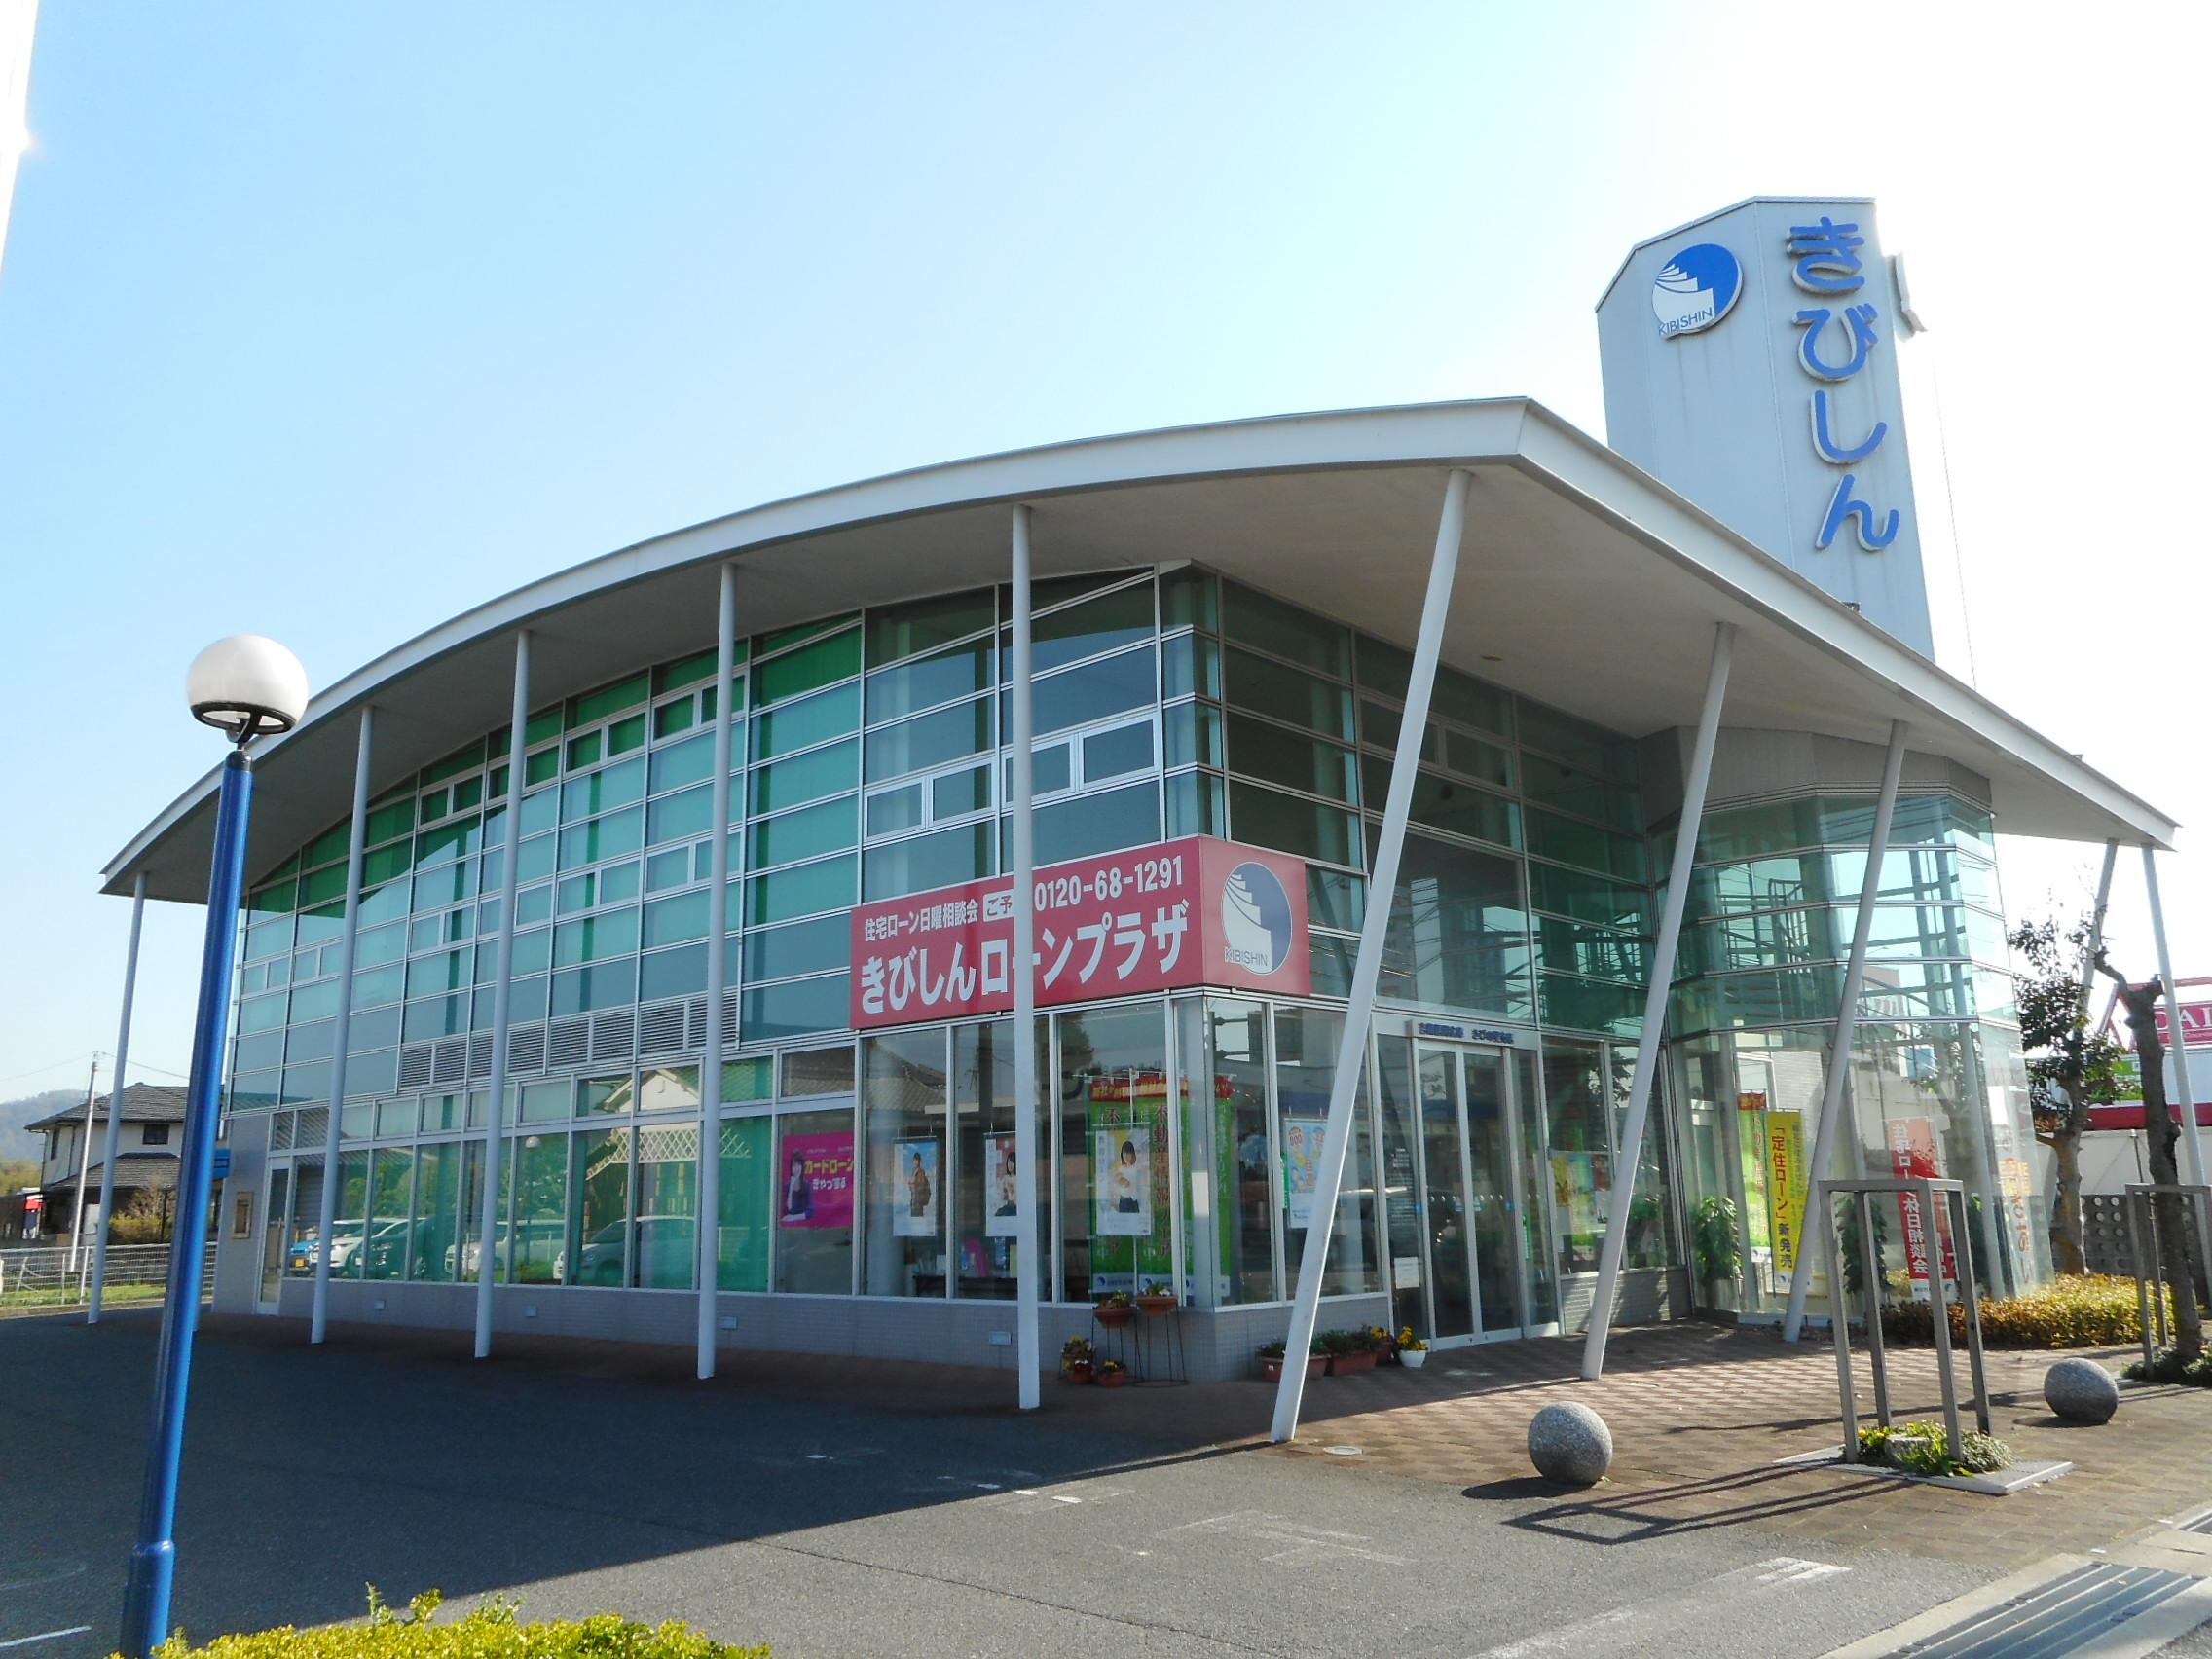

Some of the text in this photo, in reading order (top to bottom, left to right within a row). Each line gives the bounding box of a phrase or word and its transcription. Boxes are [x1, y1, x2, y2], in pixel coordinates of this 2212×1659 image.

[1658, 306, 1714, 336] KIBISHIN
[1786, 216, 1899, 552] きびしん
[865, 899, 978, 941] 住宅ローン日曜相談会
[1034, 855, 1183, 912] 0120-68-1291
[1224, 946, 1269, 966] KIBISHIN
